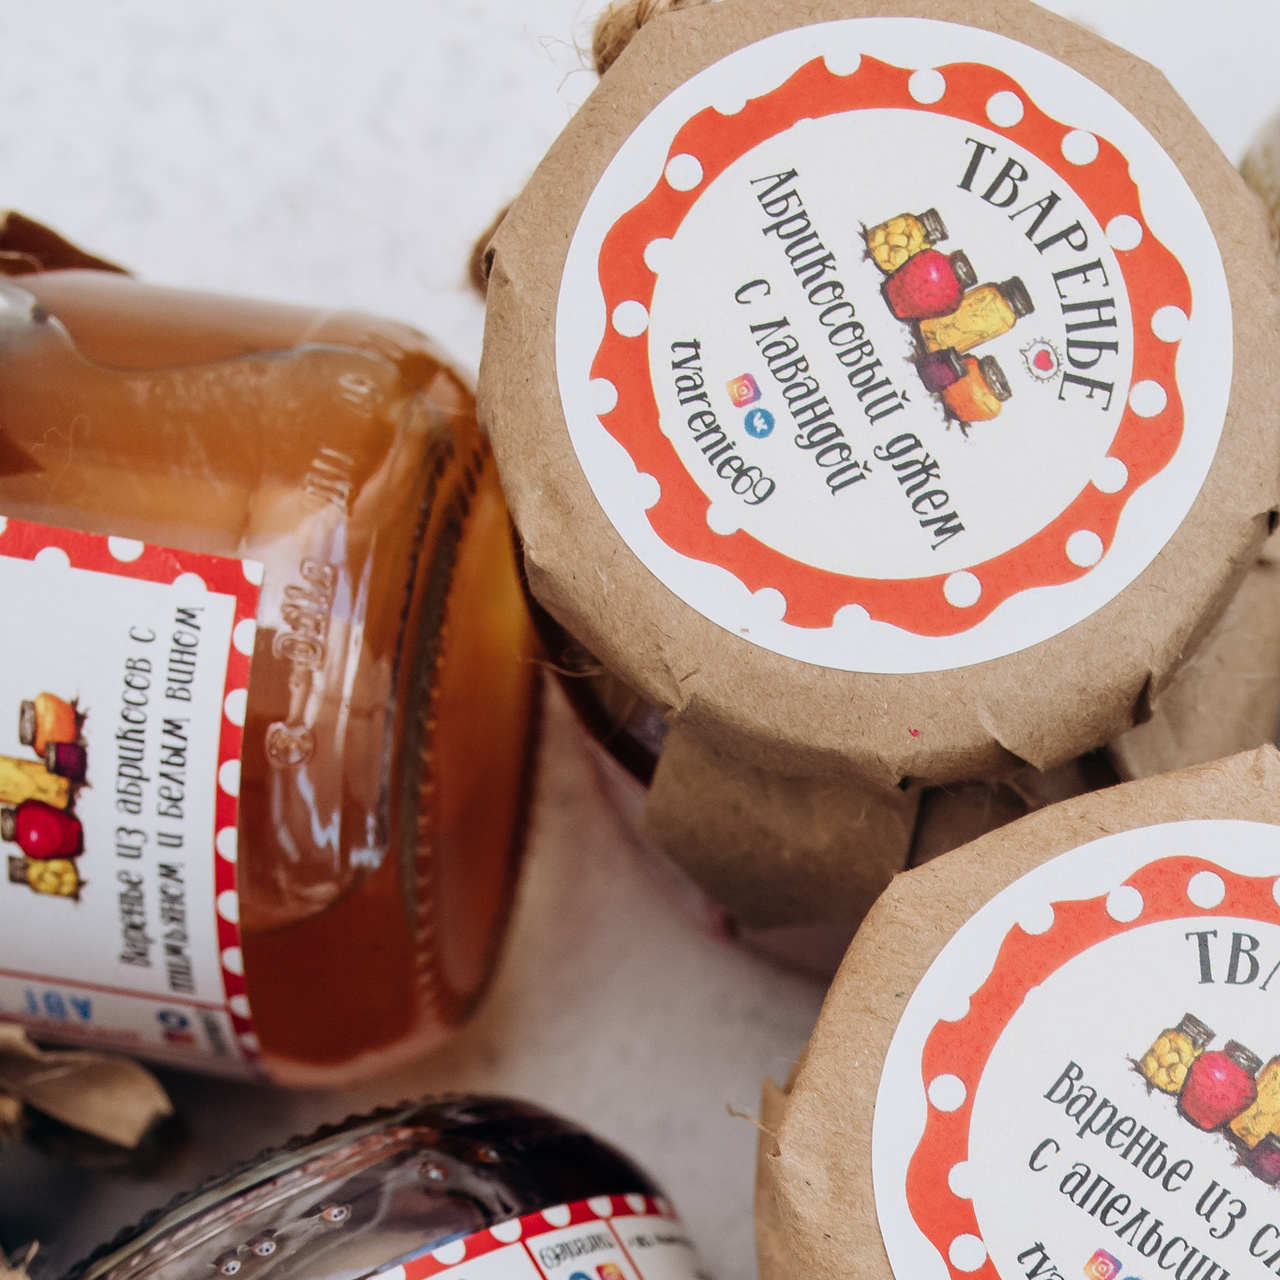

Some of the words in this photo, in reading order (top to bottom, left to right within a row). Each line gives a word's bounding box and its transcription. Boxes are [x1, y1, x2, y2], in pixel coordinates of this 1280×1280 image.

[734, 278, 772, 305] с
[956, 137, 1120, 412] ТВАРЕНЬЕ
[749, 167, 912, 427] Абрикосовый
[872, 432, 966, 552] джем
[749, 316, 868, 497] лавандой
[670, 337, 777, 506] tvarenie69
[128, 626, 157, 644] с
[165, 607, 204, 703] вином
[115, 657, 152, 816] абрикосов
[157, 717, 190, 820] белым
[114, 825, 148, 861] из
[156, 831, 185, 850] и
[1028, 1137, 1061, 1173] с
[1042, 1060, 1194, 1193] Варенье
[1194, 1184, 1248, 1236] из
